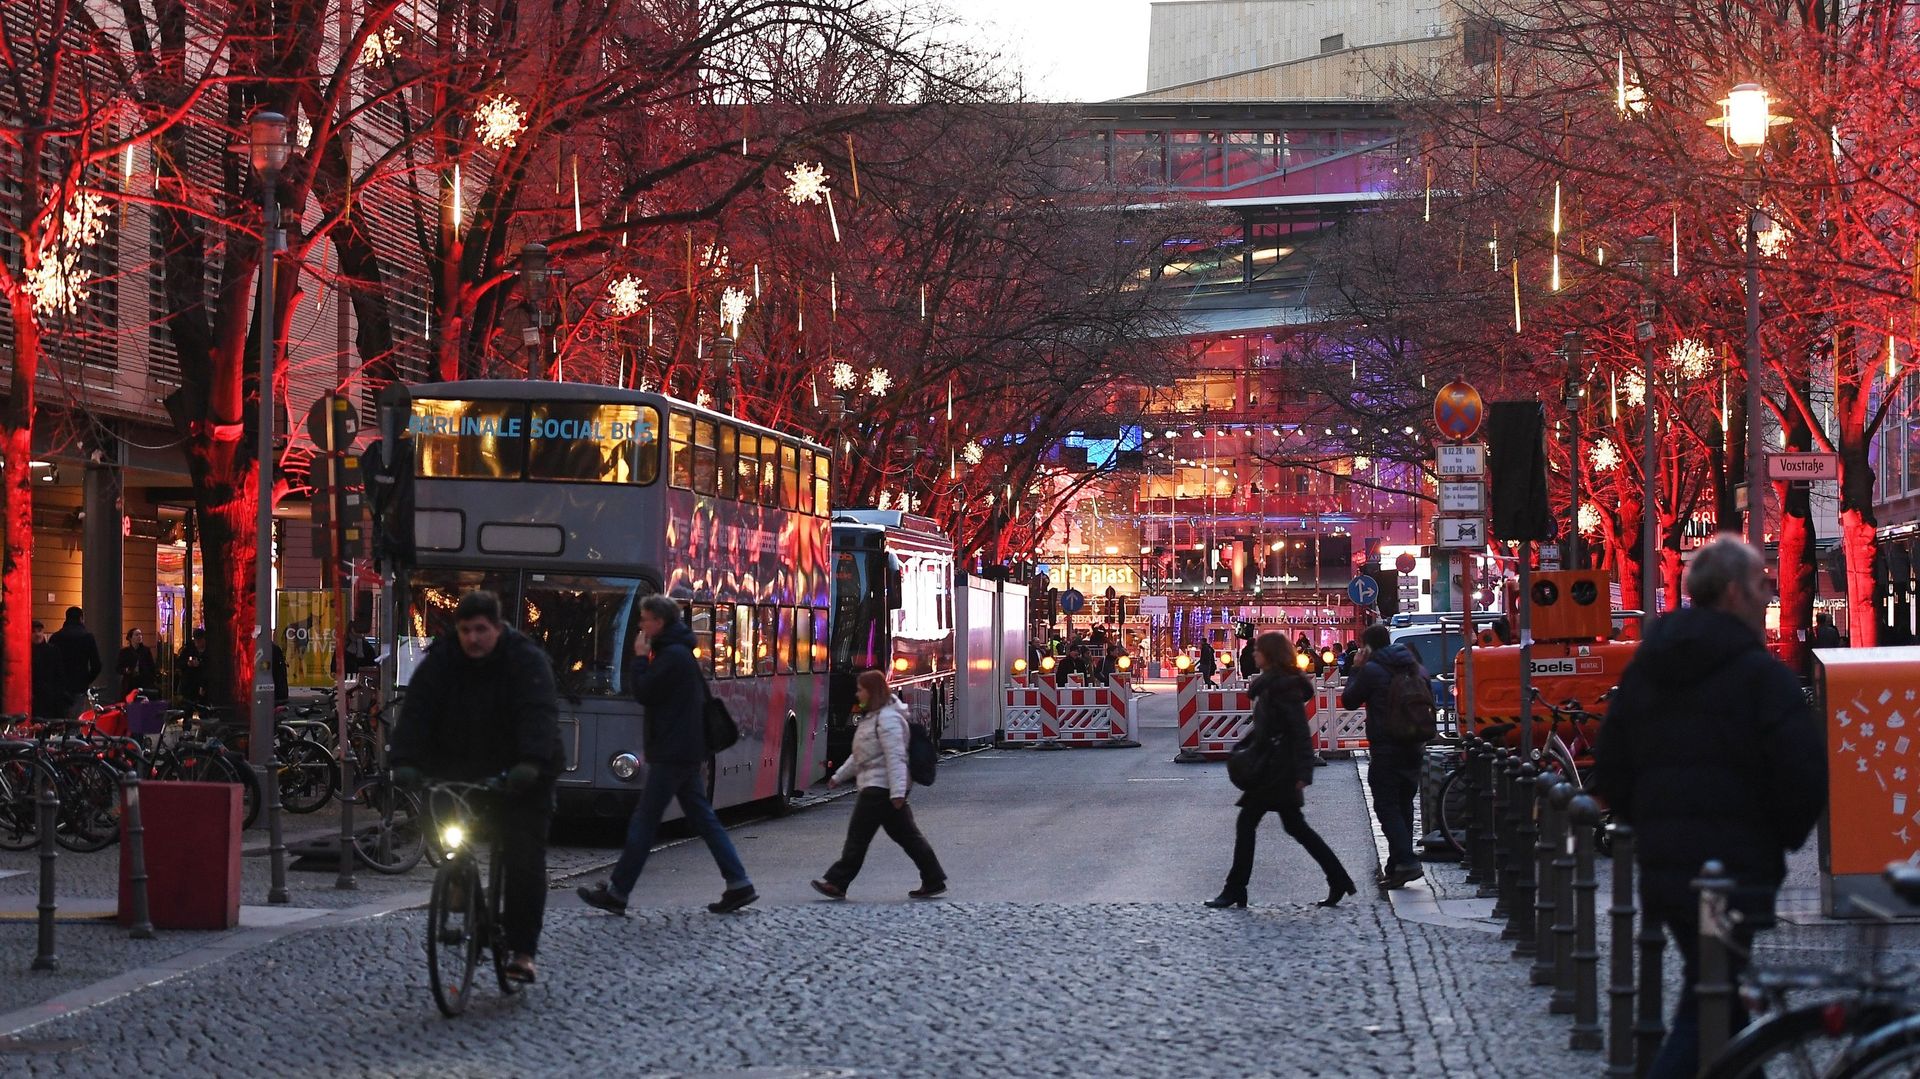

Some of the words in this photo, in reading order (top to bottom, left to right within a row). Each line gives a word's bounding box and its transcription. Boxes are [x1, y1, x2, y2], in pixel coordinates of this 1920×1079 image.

[408, 415, 522, 437] BERLINALE
[530, 418, 605, 440] SOCIAL
[611, 422, 654, 443] BUS
[1780, 458, 1824, 473] Voxstraße
[1081, 564, 1134, 584] Palast
[1261, 616, 1309, 625] THEATER
[1312, 616, 1350, 625] BERLIN
